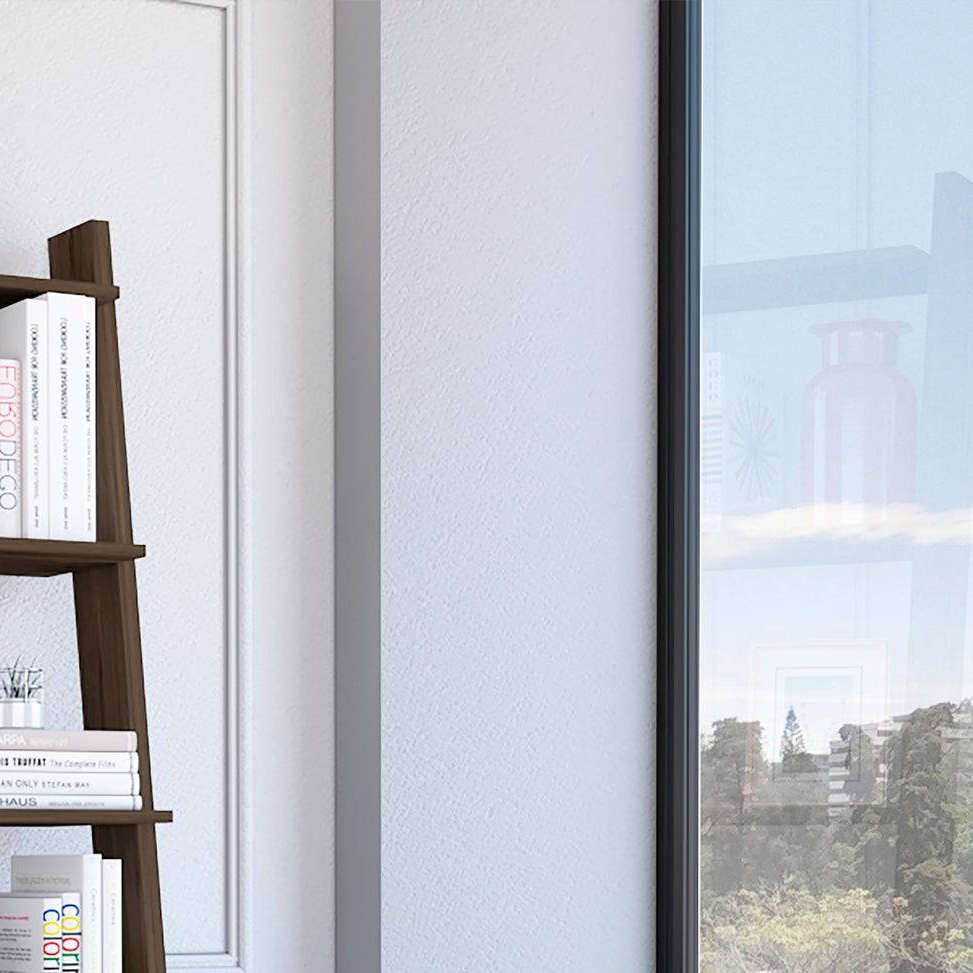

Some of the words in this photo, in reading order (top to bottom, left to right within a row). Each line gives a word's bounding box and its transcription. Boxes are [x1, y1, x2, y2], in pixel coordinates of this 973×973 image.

[50, 759, 62, 767] The
[64, 760, 96, 769] Complete
[98, 760, 116, 768] Films
[15, 780, 38, 788] ONLY
